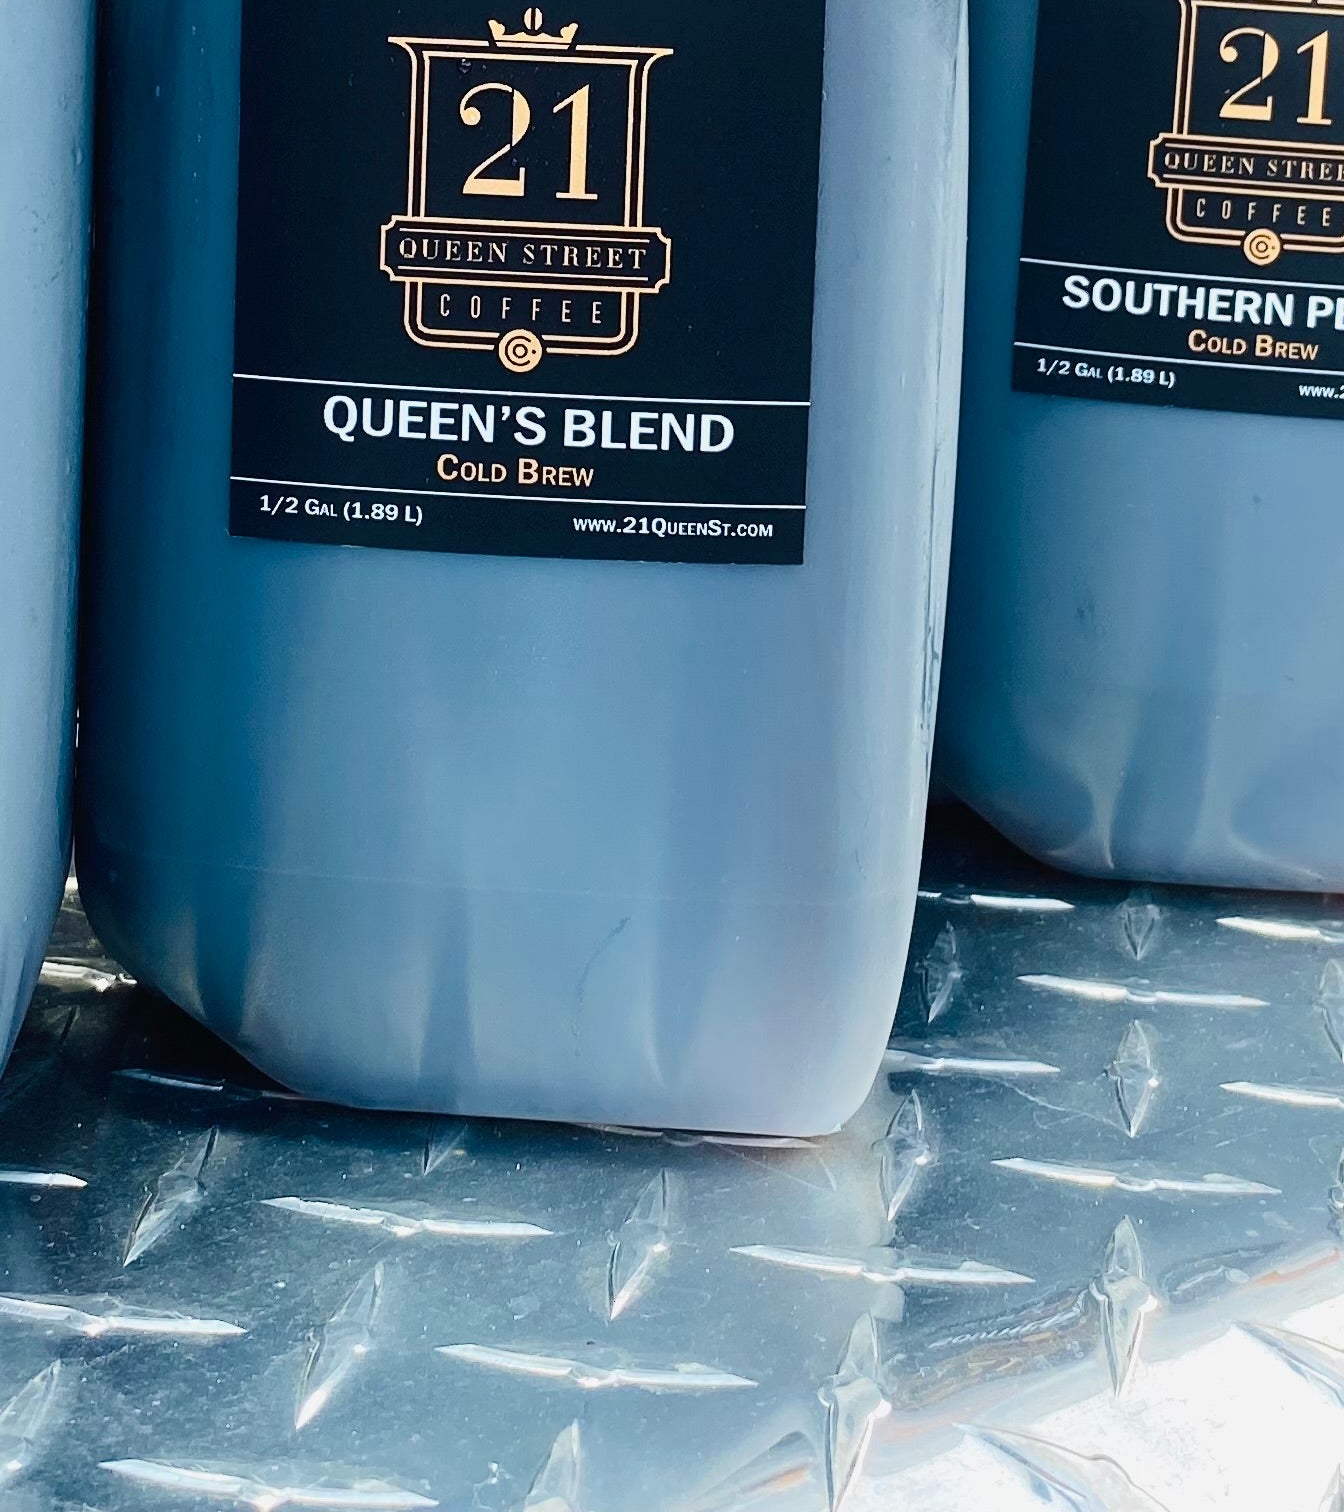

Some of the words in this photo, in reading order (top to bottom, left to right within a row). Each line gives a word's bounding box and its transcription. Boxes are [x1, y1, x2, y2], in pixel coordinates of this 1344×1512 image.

[1219, 27, 1332, 125] 21
[459, 82, 599, 200] 21
[1164, 152, 1255, 175] QUEEN
[1197, 198, 1331, 227] COFFEE
[398, 237, 508, 264] QUEEN
[522, 243, 647, 270] STREET
[439, 292, 602, 325] COFFEE
[1062, 274, 1293, 327] SOUTHERN
[1036, 358, 1071, 376] 1/2
[1107, 365, 1155, 385] (1.89
[1159, 370, 1176, 388] L)
[322, 393, 547, 446] QUEEN'S
[563, 408, 735, 453] BLEND
[259, 493, 299, 517] 1/2
[343, 500, 399, 524] (1.89
[404, 505, 424, 526] L)
